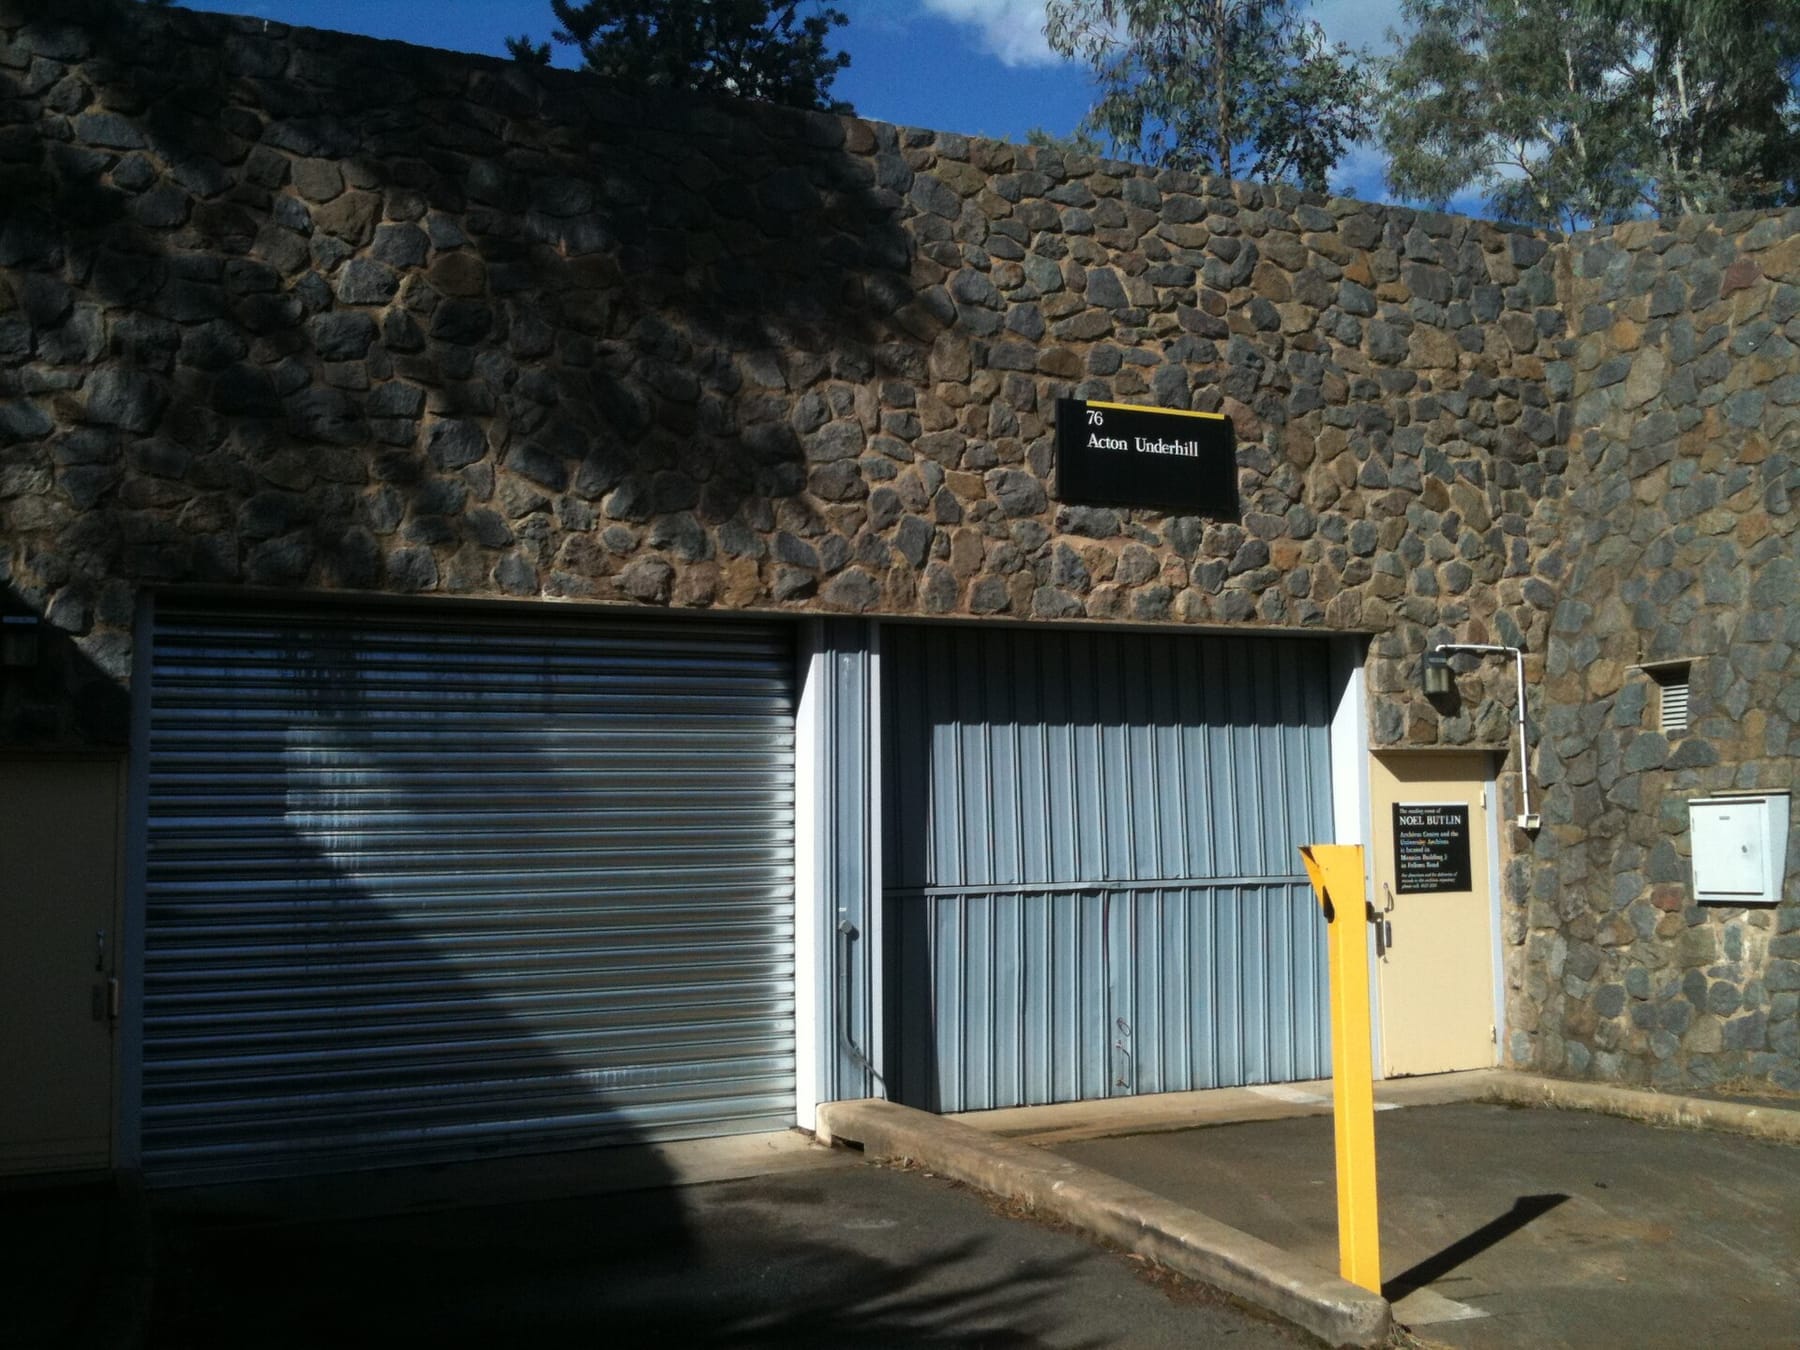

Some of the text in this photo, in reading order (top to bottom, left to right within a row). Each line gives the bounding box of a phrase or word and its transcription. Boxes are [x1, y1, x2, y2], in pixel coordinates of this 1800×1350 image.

[1086, 410, 1104, 426] 76
[1087, 432, 1199, 457] Acton Underhill
[1400, 815, 1461, 825] NOEL BUTLIN
